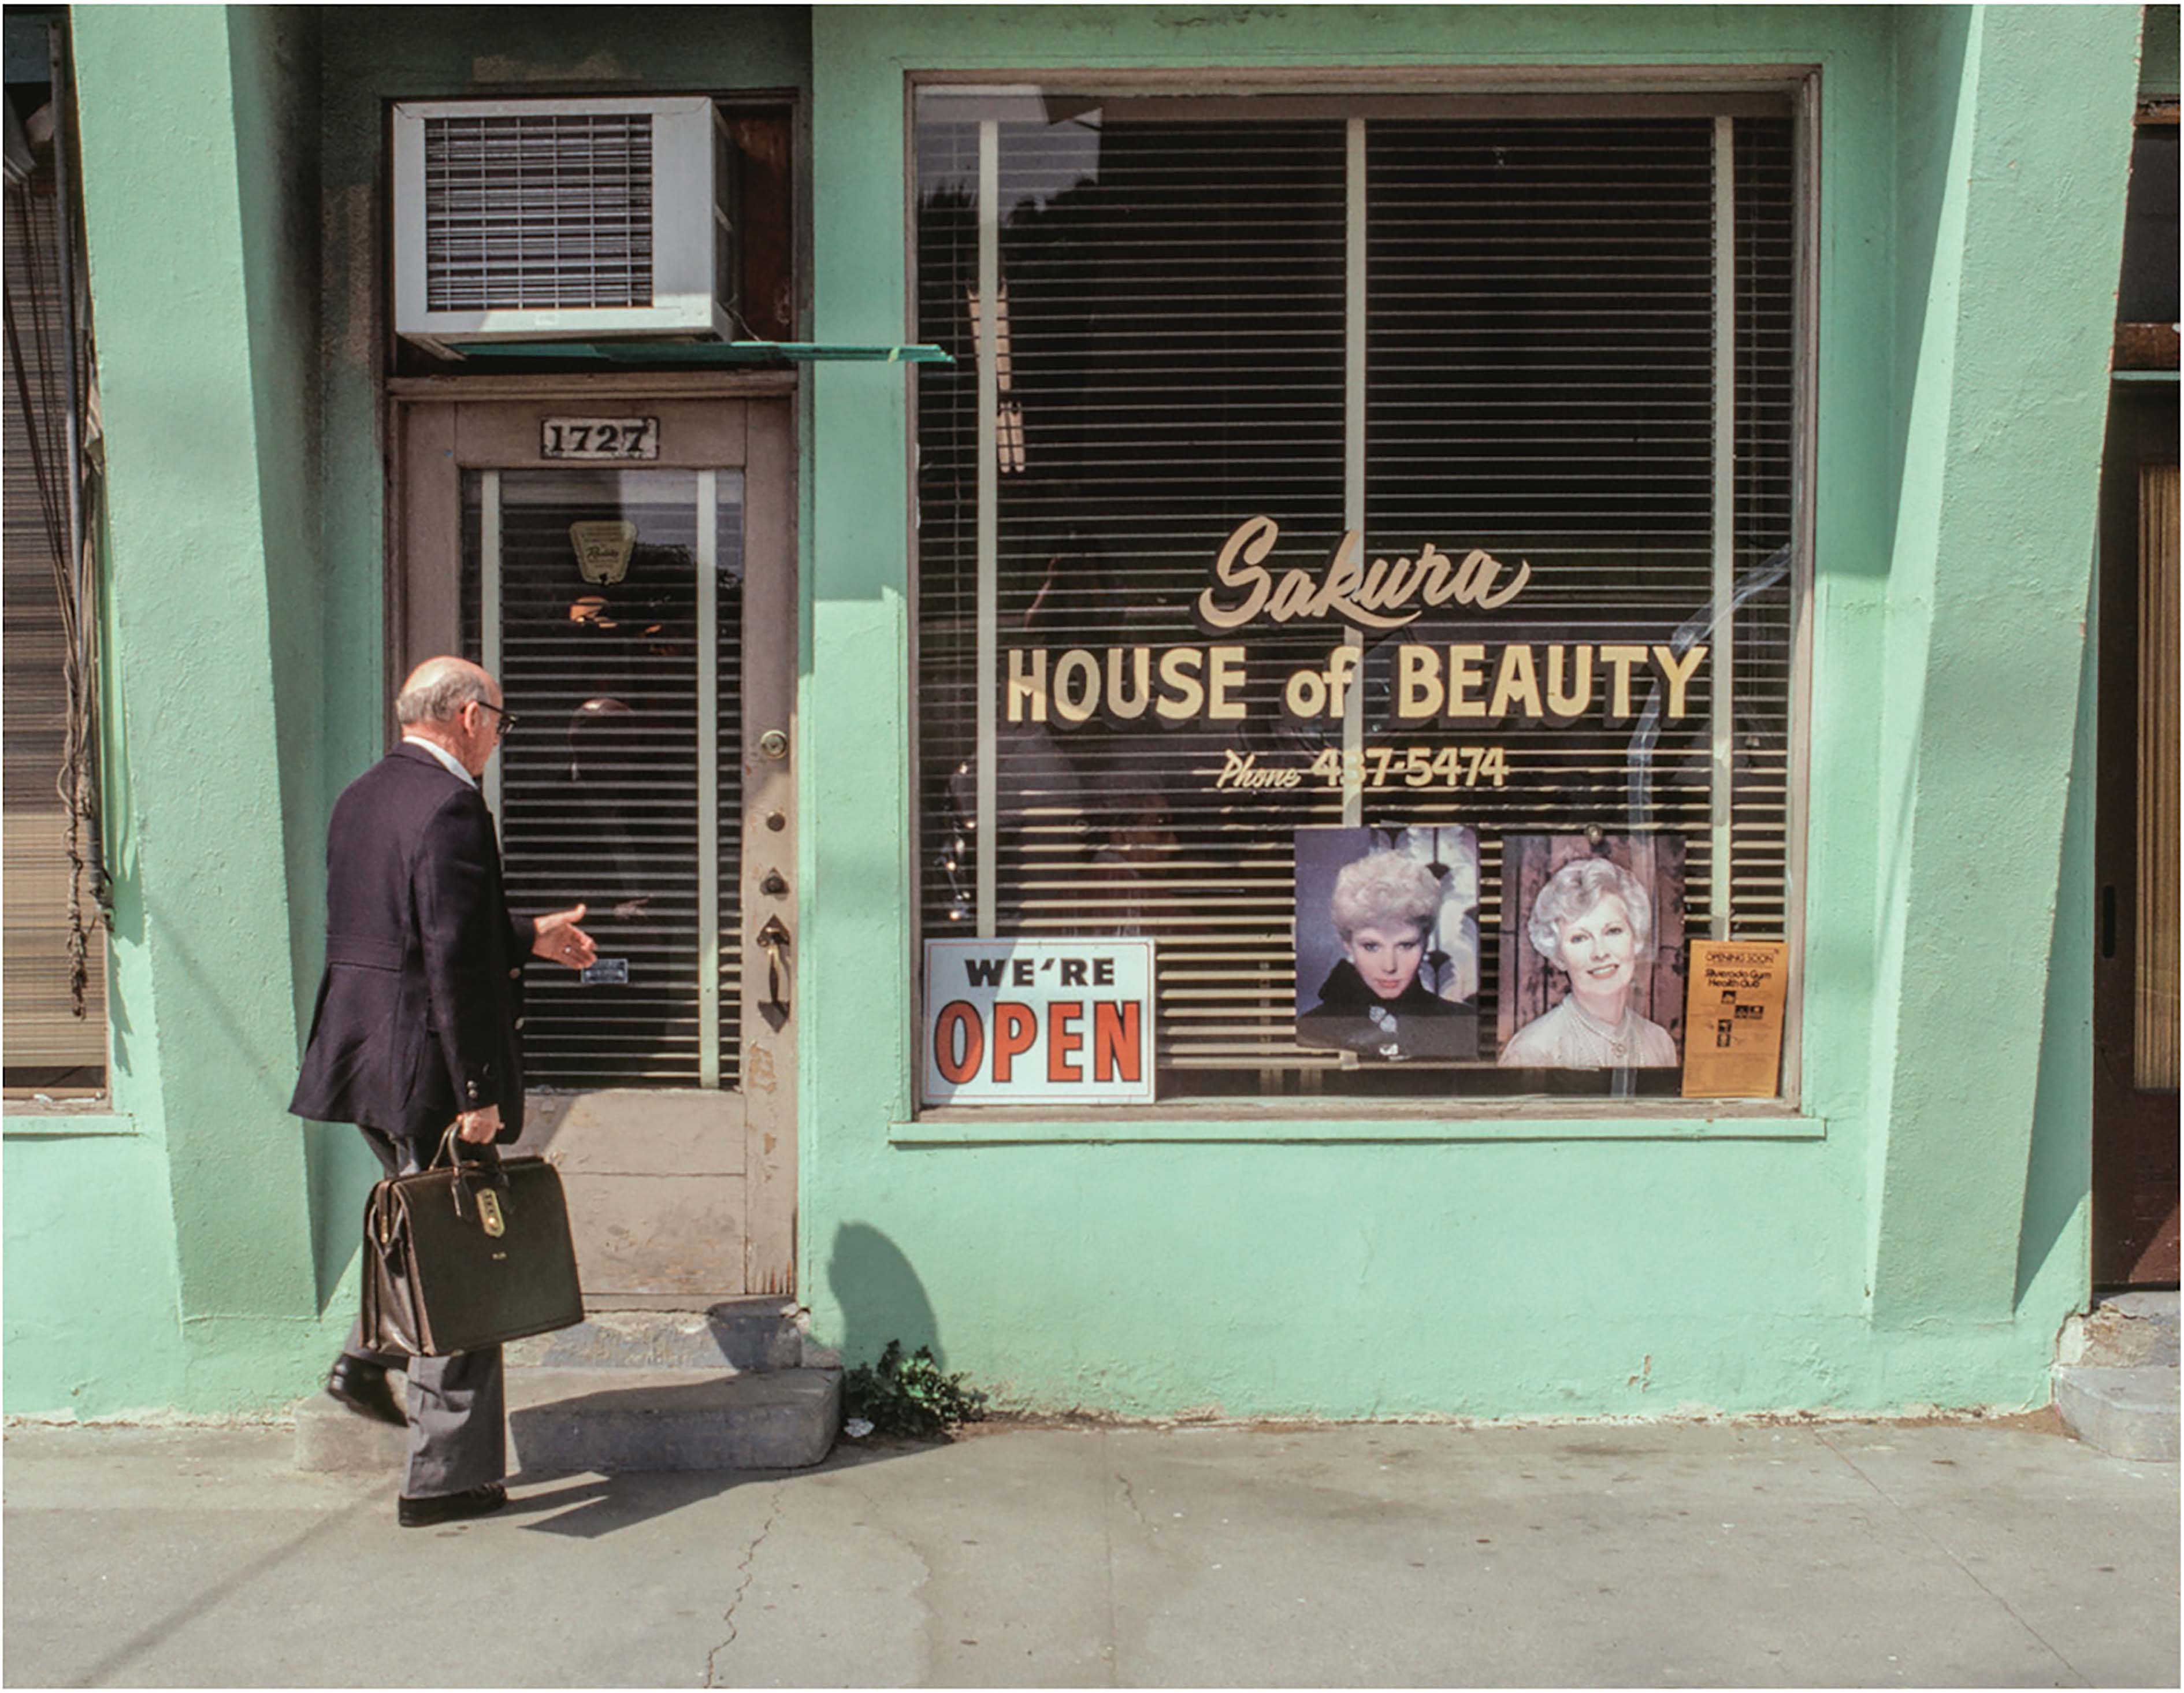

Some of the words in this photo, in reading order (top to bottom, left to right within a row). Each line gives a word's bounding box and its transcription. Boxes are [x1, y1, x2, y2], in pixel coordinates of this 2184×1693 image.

[549, 425, 649, 452] 1727
[1199, 515, 1531, 628] Sakura
[1008, 646, 1246, 721] HOUSE
[1286, 645, 1362, 718] of
[1398, 645, 1708, 718] BEAUTY
[1217, 749, 1301, 788] Phone
[1310, 748, 1510, 786] 437-5474
[965, 959, 1115, 986] WE'RE
[1705, 952, 1744, 963] OPENING
[1747, 953, 1774, 964] SOON
[1750, 969, 1772, 981] Gym
[934, 1000, 1142, 1084] OPEN
